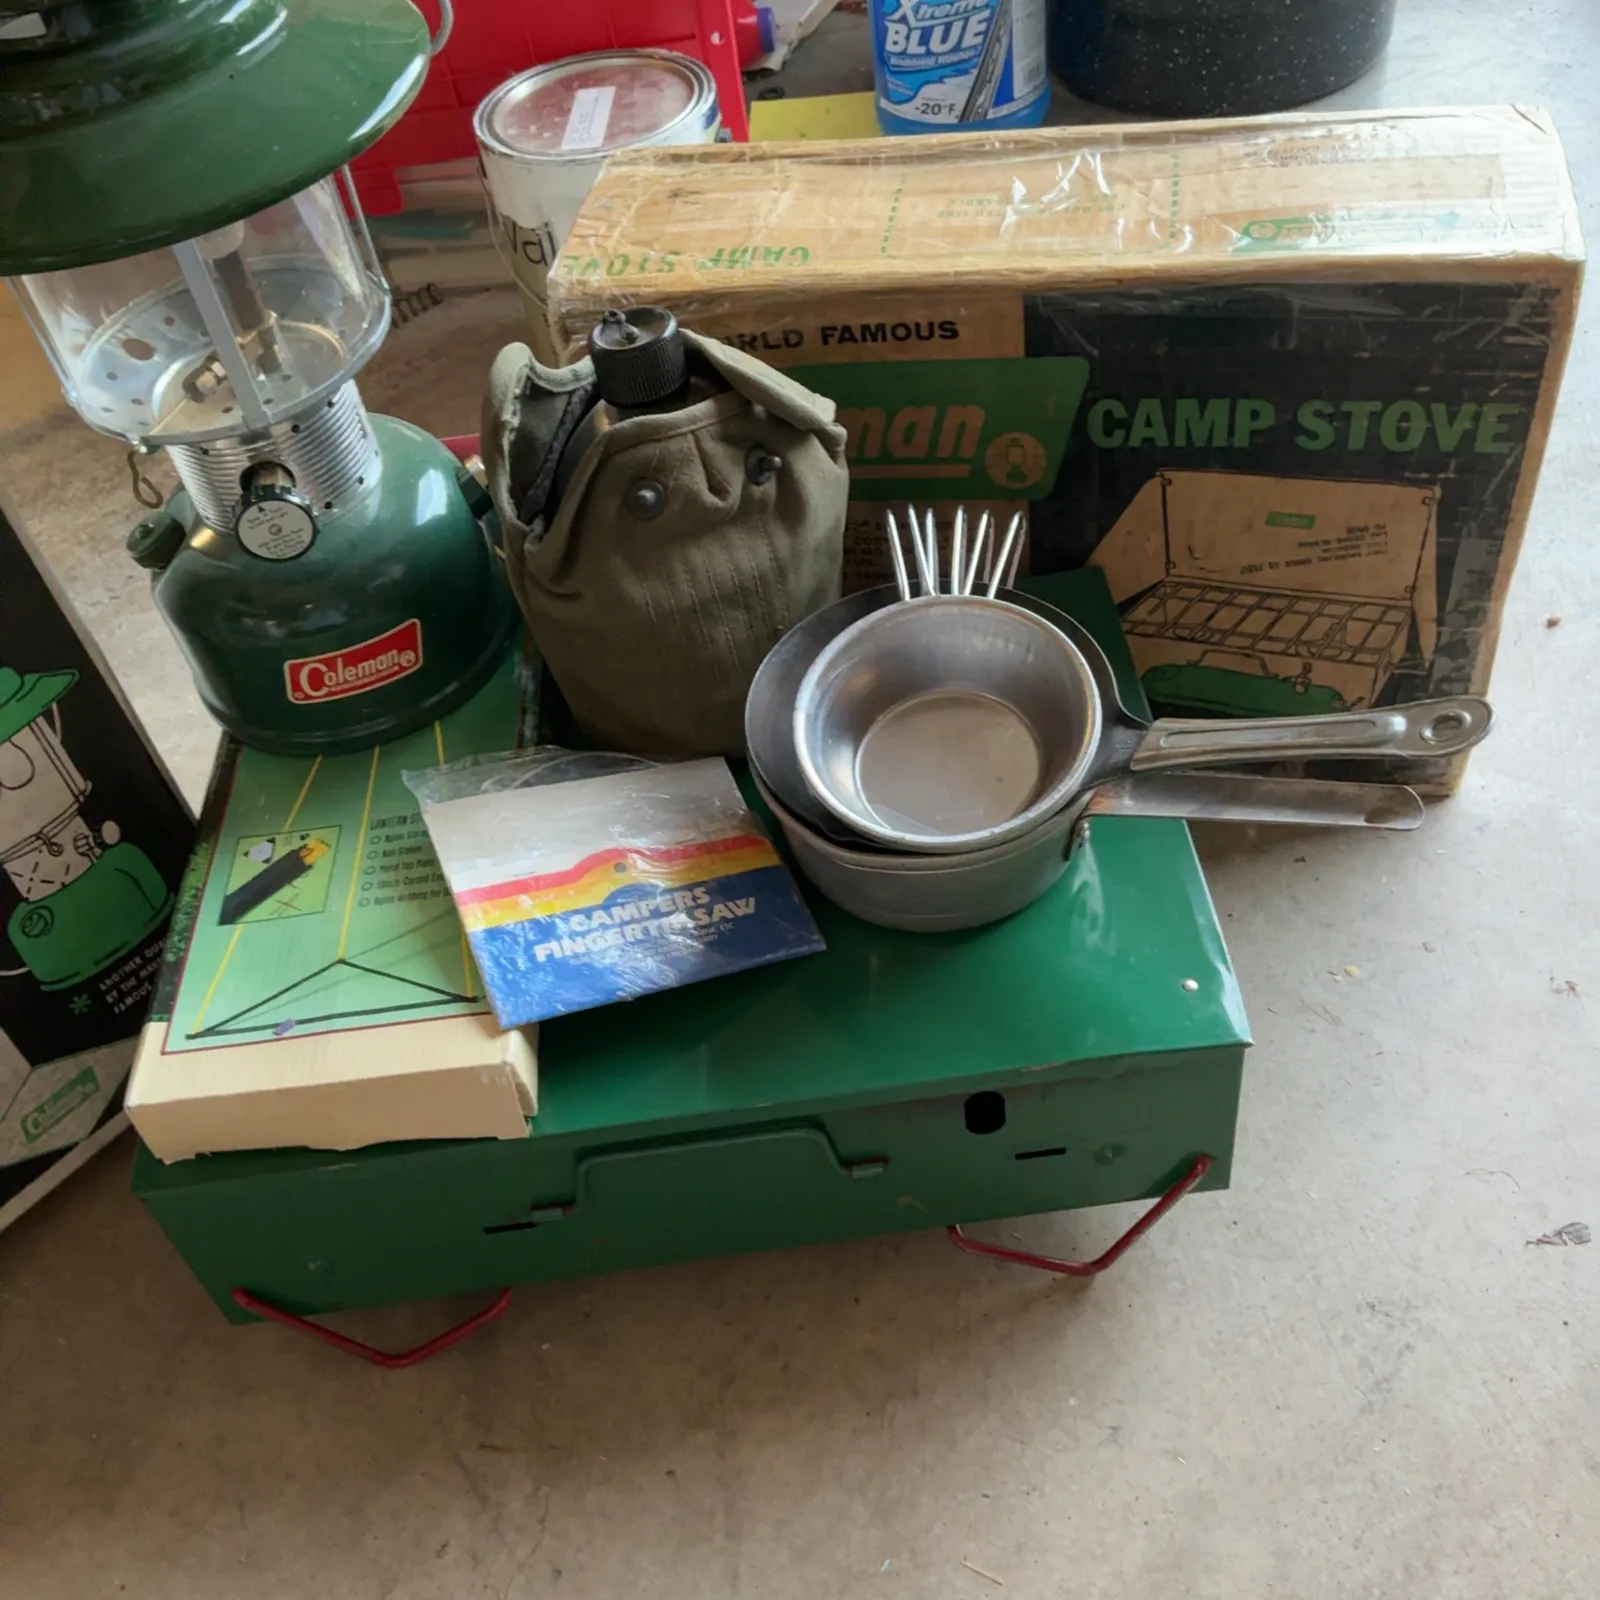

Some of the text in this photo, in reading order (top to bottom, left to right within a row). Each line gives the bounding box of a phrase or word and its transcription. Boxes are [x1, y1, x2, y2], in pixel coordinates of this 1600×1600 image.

[885, 11, 990, 55] BLUE
[562, 246, 811, 278] CAMP STOVE
[724, 320, 960, 351] RLD FAMOUS
[1086, 398, 1521, 454] CAMP STOVE
[300, 649, 399, 697] Coleman
[568, 887, 710, 932] CAMPERS
[693, 897, 756, 926] SAW
[99, 956, 142, 991] ANOTHER
[120, 976, 138, 992] THE
[113, 981, 152, 1015] FAMOUS
